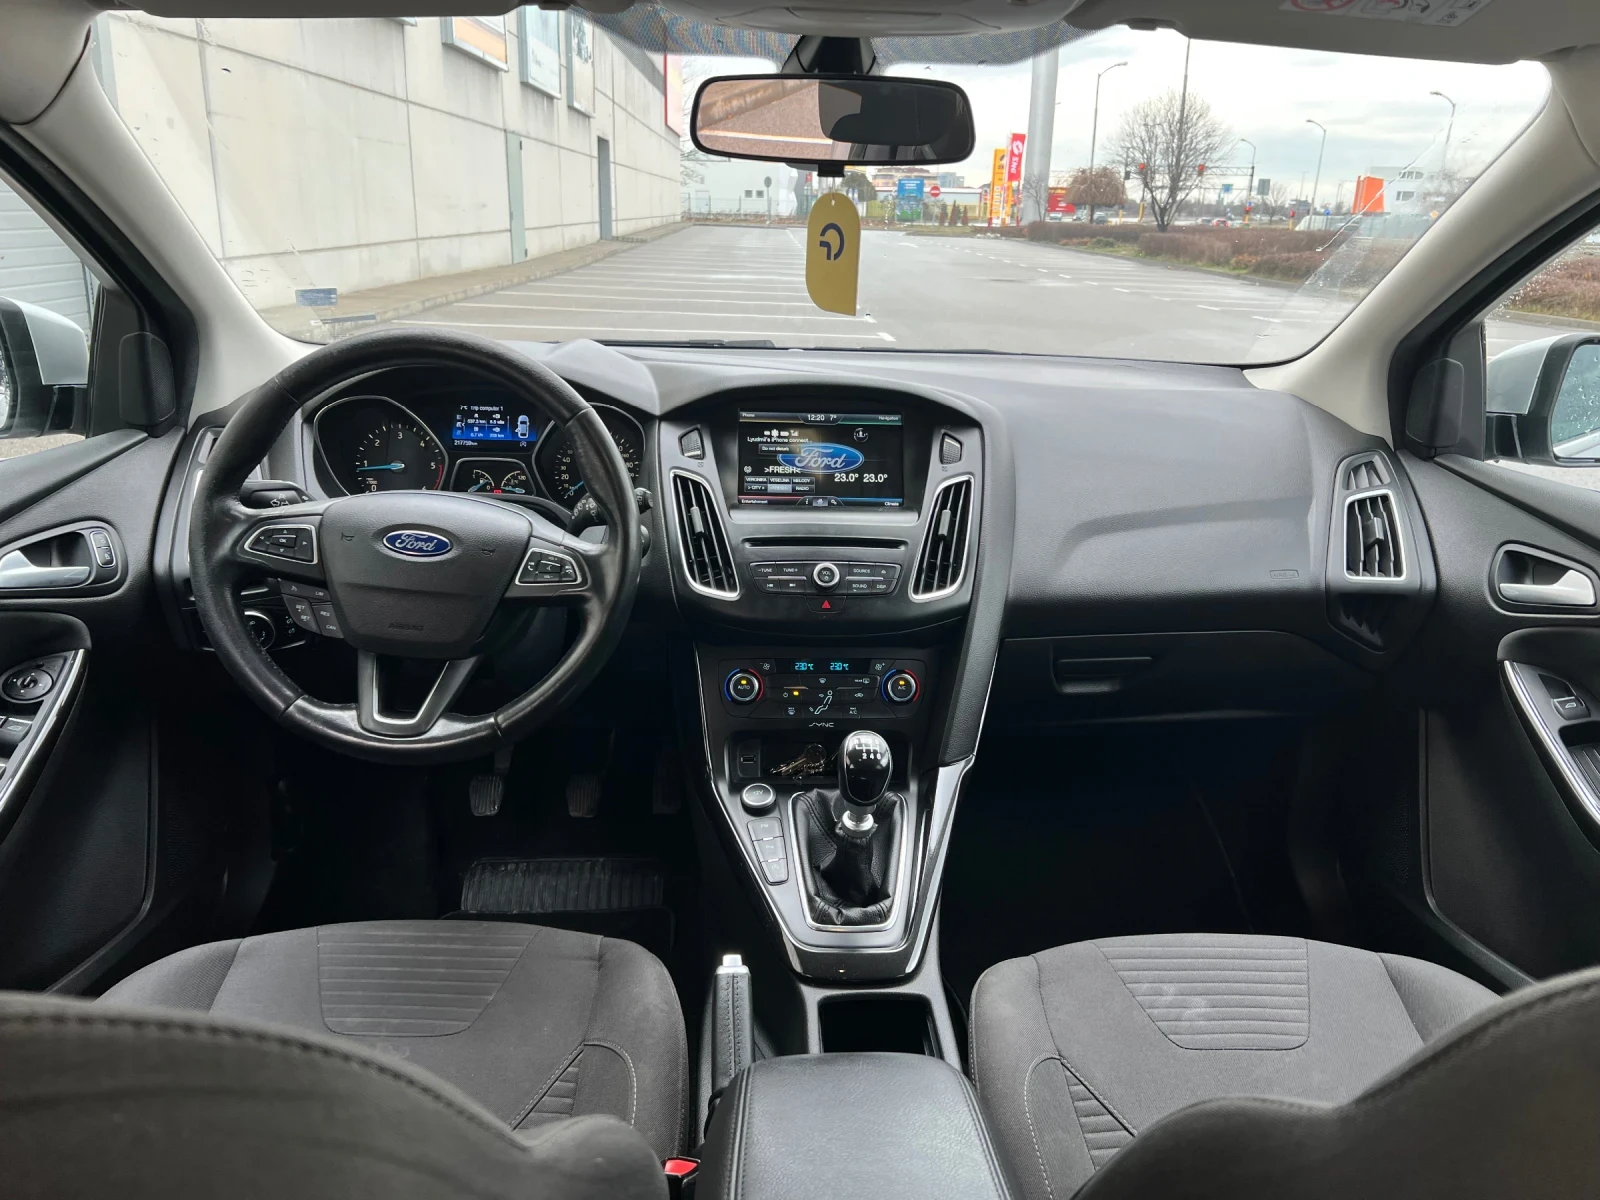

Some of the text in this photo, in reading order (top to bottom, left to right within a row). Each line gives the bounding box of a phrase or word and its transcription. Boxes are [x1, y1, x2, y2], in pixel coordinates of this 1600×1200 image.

[795, 448, 846, 469] Ford
[834, 473, 888, 483] 23.0° 23.0°
[396, 533, 438, 551] Ford
